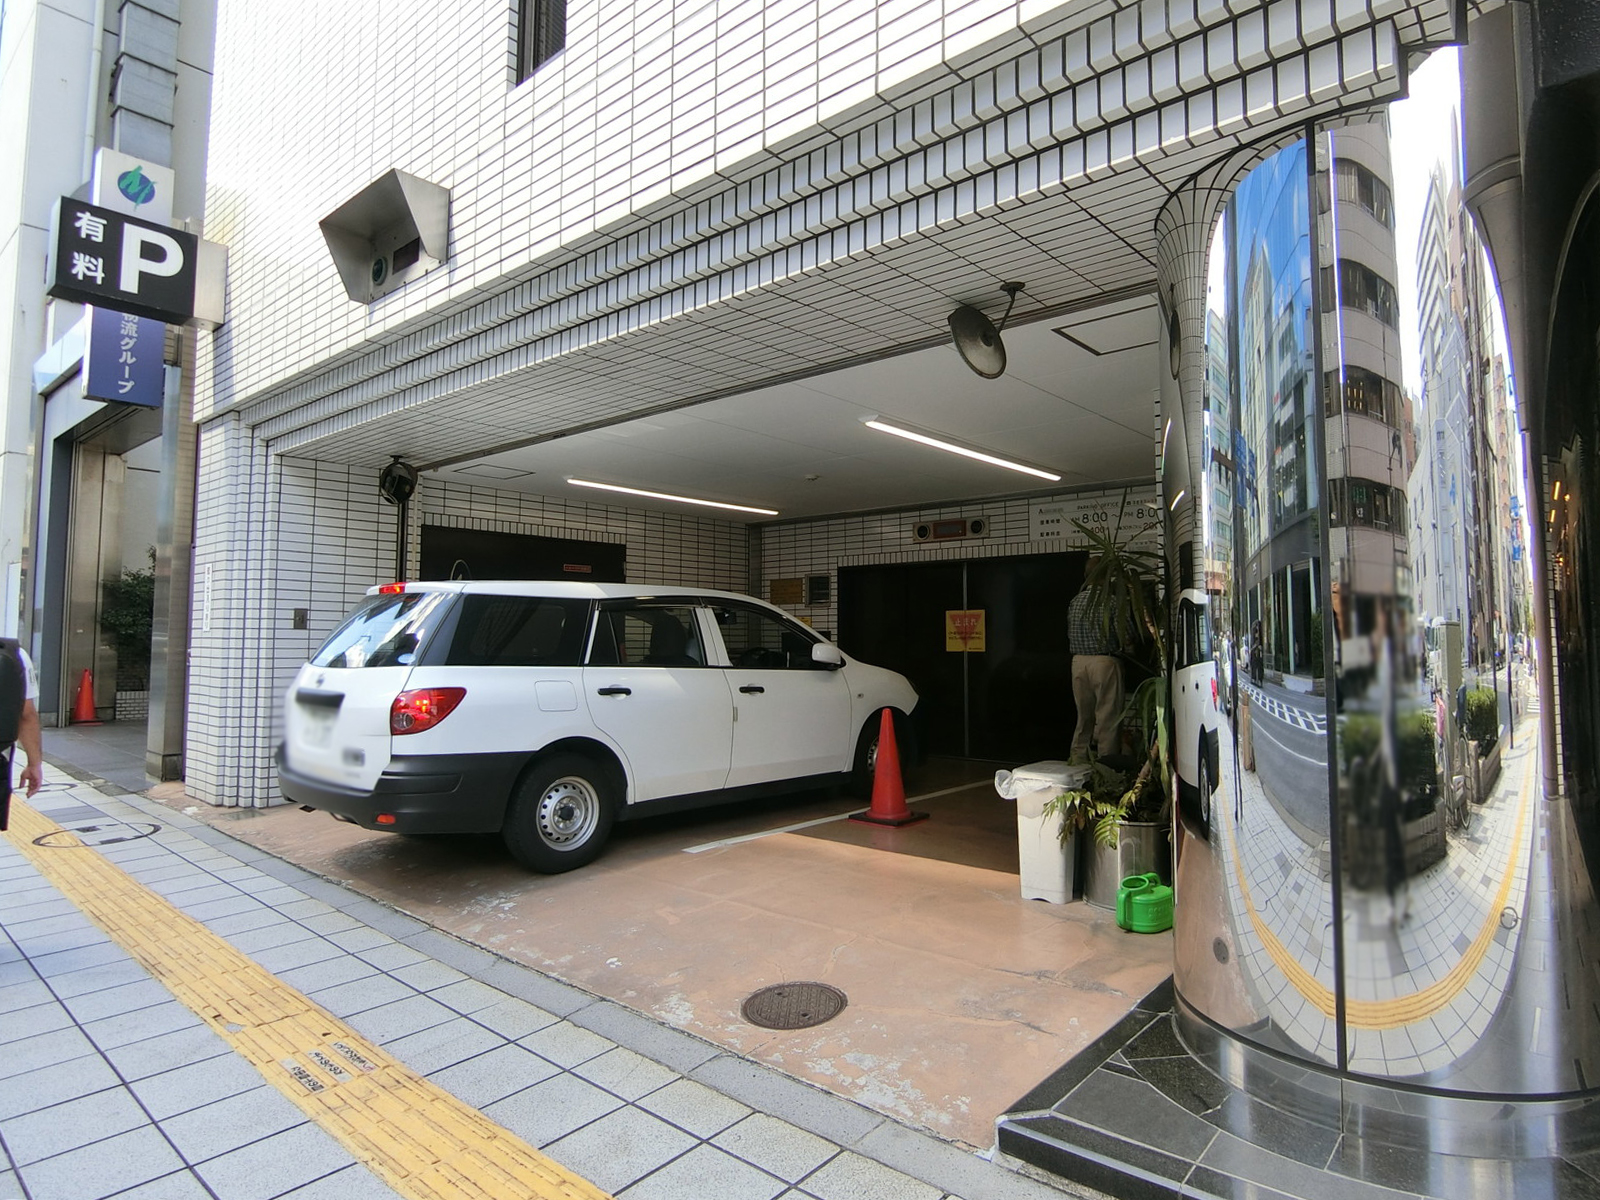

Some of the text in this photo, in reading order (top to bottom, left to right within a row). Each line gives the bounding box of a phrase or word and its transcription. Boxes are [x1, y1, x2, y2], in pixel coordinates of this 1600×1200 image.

[71, 210, 108, 285] 有料
[119, 221, 185, 295] P
[1082, 511, 1108, 524] 8:00
